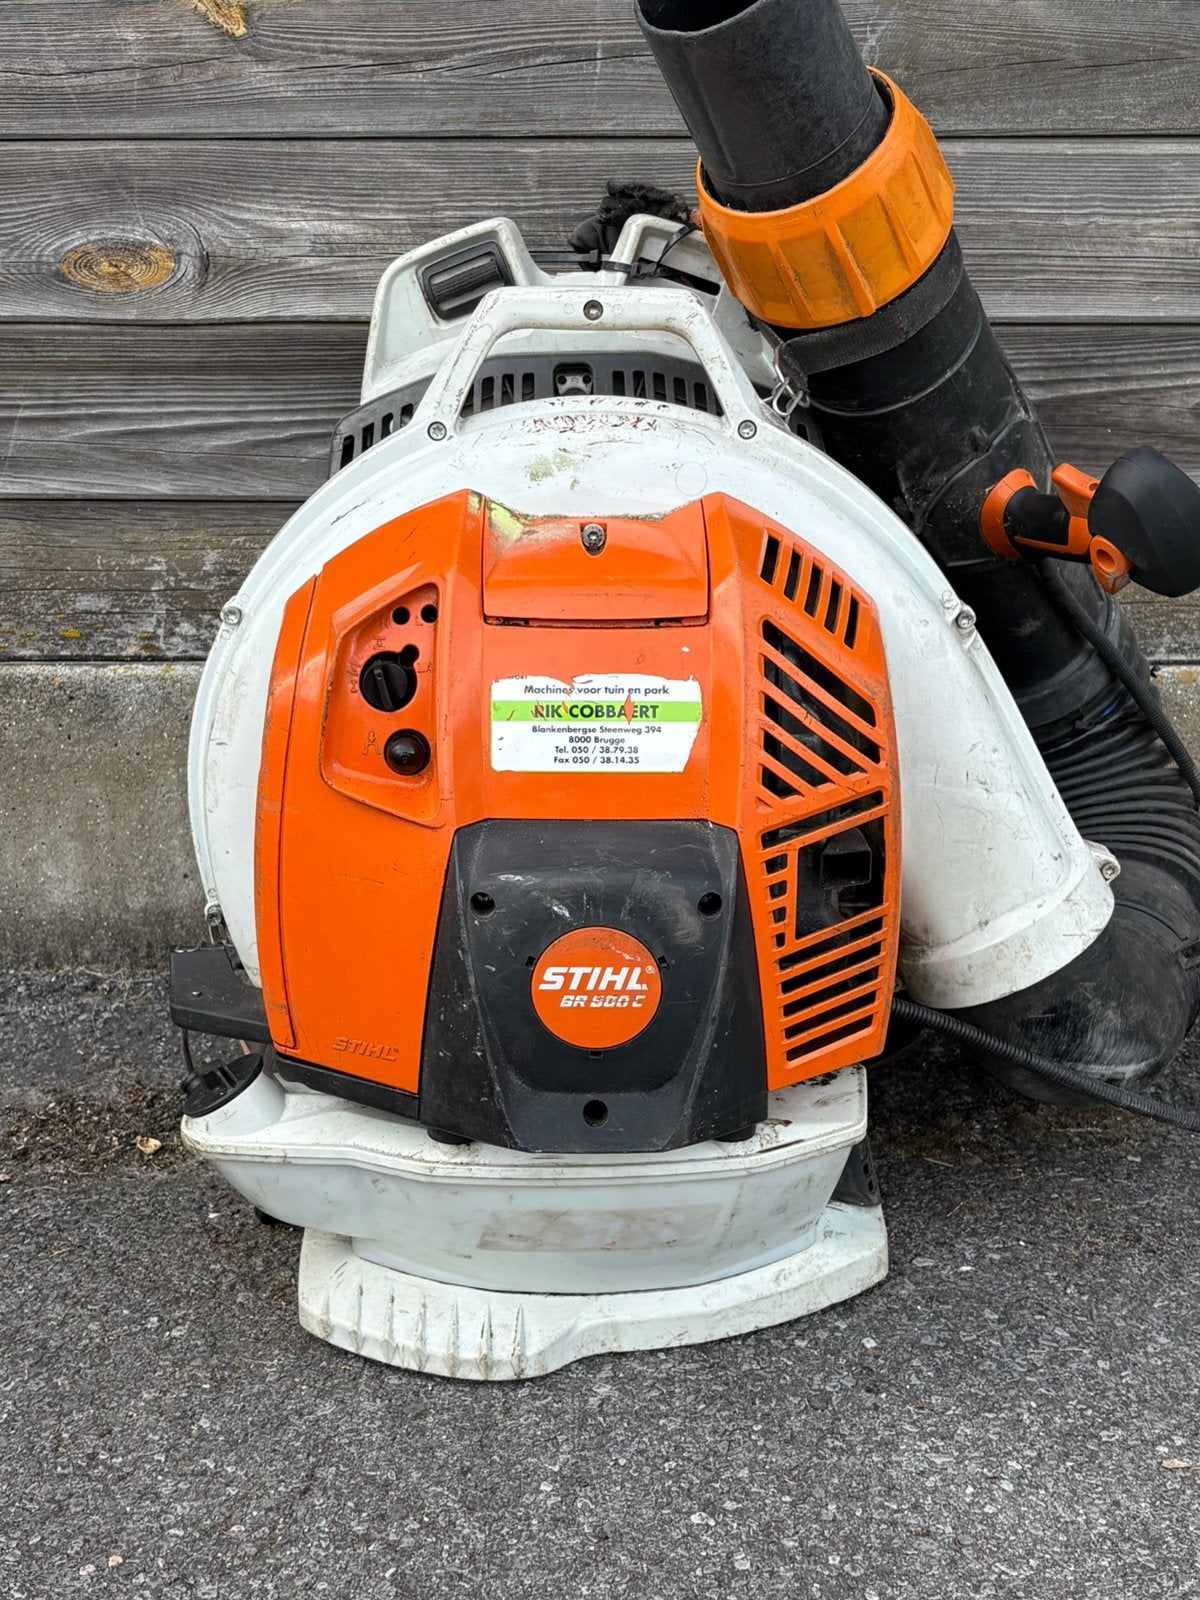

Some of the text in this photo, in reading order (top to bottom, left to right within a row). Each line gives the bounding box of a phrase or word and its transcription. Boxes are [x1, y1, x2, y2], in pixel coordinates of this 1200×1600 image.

[524, 685, 573, 695] Machines
[605, 685, 624, 694] tuin
[644, 685, 669, 696] park
[532, 725, 597, 735] Blankenbergse
[600, 726, 642, 735] Steenweg
[594, 736, 625, 745] Brugge
[599, 746, 639, 754] 38.79.38
[572, 756, 590, 764] 050
[600, 756, 640, 764] 38.14.35
[560, 994, 588, 1008] BR
[631, 994, 647, 1008] C
[332, 1036, 398, 1062] STIHL
